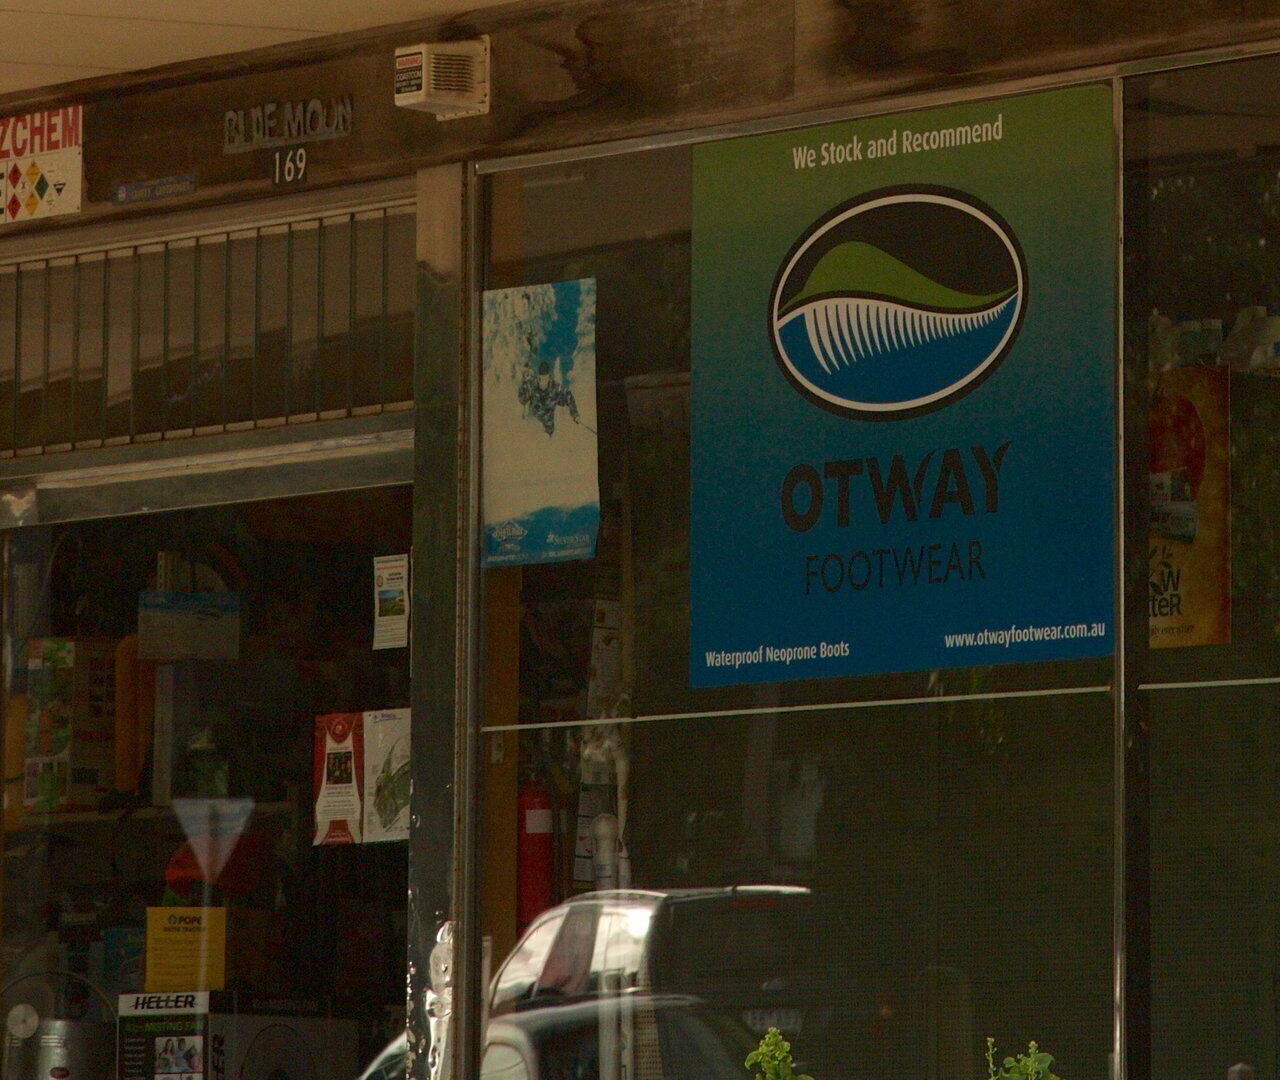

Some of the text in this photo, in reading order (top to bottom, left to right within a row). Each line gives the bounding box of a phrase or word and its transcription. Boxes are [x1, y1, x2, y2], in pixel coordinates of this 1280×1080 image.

[274, 148, 306, 184] 169
[792, 113, 1003, 170] We Stock and Recommend
[781, 440, 1012, 533] OTWAY
[804, 539, 986, 595] FOOTWEAR
[705, 622, 1106, 669] Waterproof Neoprone Boots www.otwayfootwear.com.au
[132, 994, 197, 1010] HELLER
